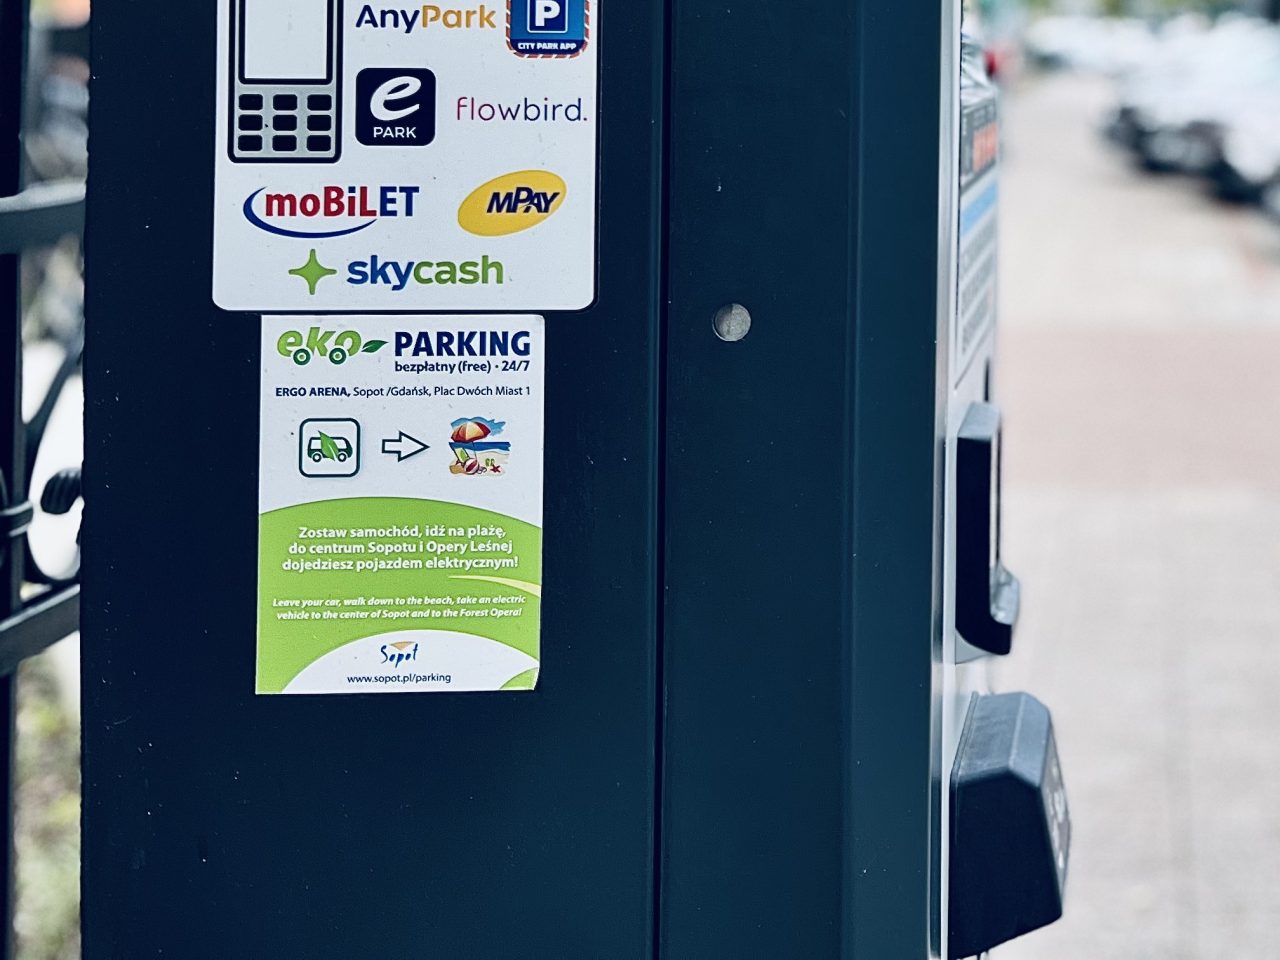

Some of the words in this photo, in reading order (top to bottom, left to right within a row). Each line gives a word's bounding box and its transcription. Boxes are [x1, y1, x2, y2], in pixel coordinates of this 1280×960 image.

[355, 4, 497, 34] AnyPark
[535, 0, 560, 26] P
[370, 76, 422, 121] e
[456, 97, 588, 121] flowbird.
[373, 127, 417, 139] PARK
[265, 186, 419, 217] moBiLET
[346, 255, 503, 291] skycash
[276, 326, 362, 365] eko
[395, 331, 531, 356] PARKING
[395, 360, 456, 374] bezpłatny
[458, 360, 491, 374] (free)
[501, 360, 530, 373] 24/7
[275, 387, 307, 397] ERGO
[309, 387, 351, 398] ARENA,
[353, 386, 385, 398] Sopot
[434, 386, 455, 396] Plac
[457, 386, 493, 396] Dwóch
[496, 386, 521, 396] Miast
[525, 387, 531, 396] 1
[298, 527, 348, 539] Zostaw
[350, 526, 423, 539] samochód,
[425, 525, 446, 537] idź
[448, 528, 464, 537] na
[467, 525, 507, 539] plażę,
[288, 543, 306, 554] do
[309, 543, 365, 553] centrum
[367, 541, 416, 555] Sopotu
[419, 541, 424, 553] i
[426, 541, 468, 555] Opery
[470, 540, 513, 554] Leśnej
[282, 558, 354, 573] dojedziesz
[356, 557, 422, 572] pojazdem
[425, 556, 519, 571] elektrycznym!
[272, 599, 299, 607] Leave
[301, 599, 323, 608] your
[324, 599, 342, 607] car,
[343, 597, 366, 606] walk
[367, 597, 394, 606] down
[395, 597, 405, 605] to
[406, 597, 423, 605] the
[424, 596, 454, 606] beach,
[456, 596, 478, 604] take
[492, 595, 526, 604] electric
[276, 610, 309, 620] vehicle
[311, 611, 321, 619] to
[322, 610, 338, 619] the
[339, 610, 369, 618] center
[371, 609, 381, 618] of
[381, 609, 410, 620] Sopot
[411, 609, 430, 617] and
[431, 609, 441, 617] to
[443, 609, 458, 617] the
[459, 608, 489, 617] Forest
[490, 608, 522, 618] Opera!
[380, 644, 419, 668] Sopot
[347, 673, 452, 685] www.sopot.pl/parking
